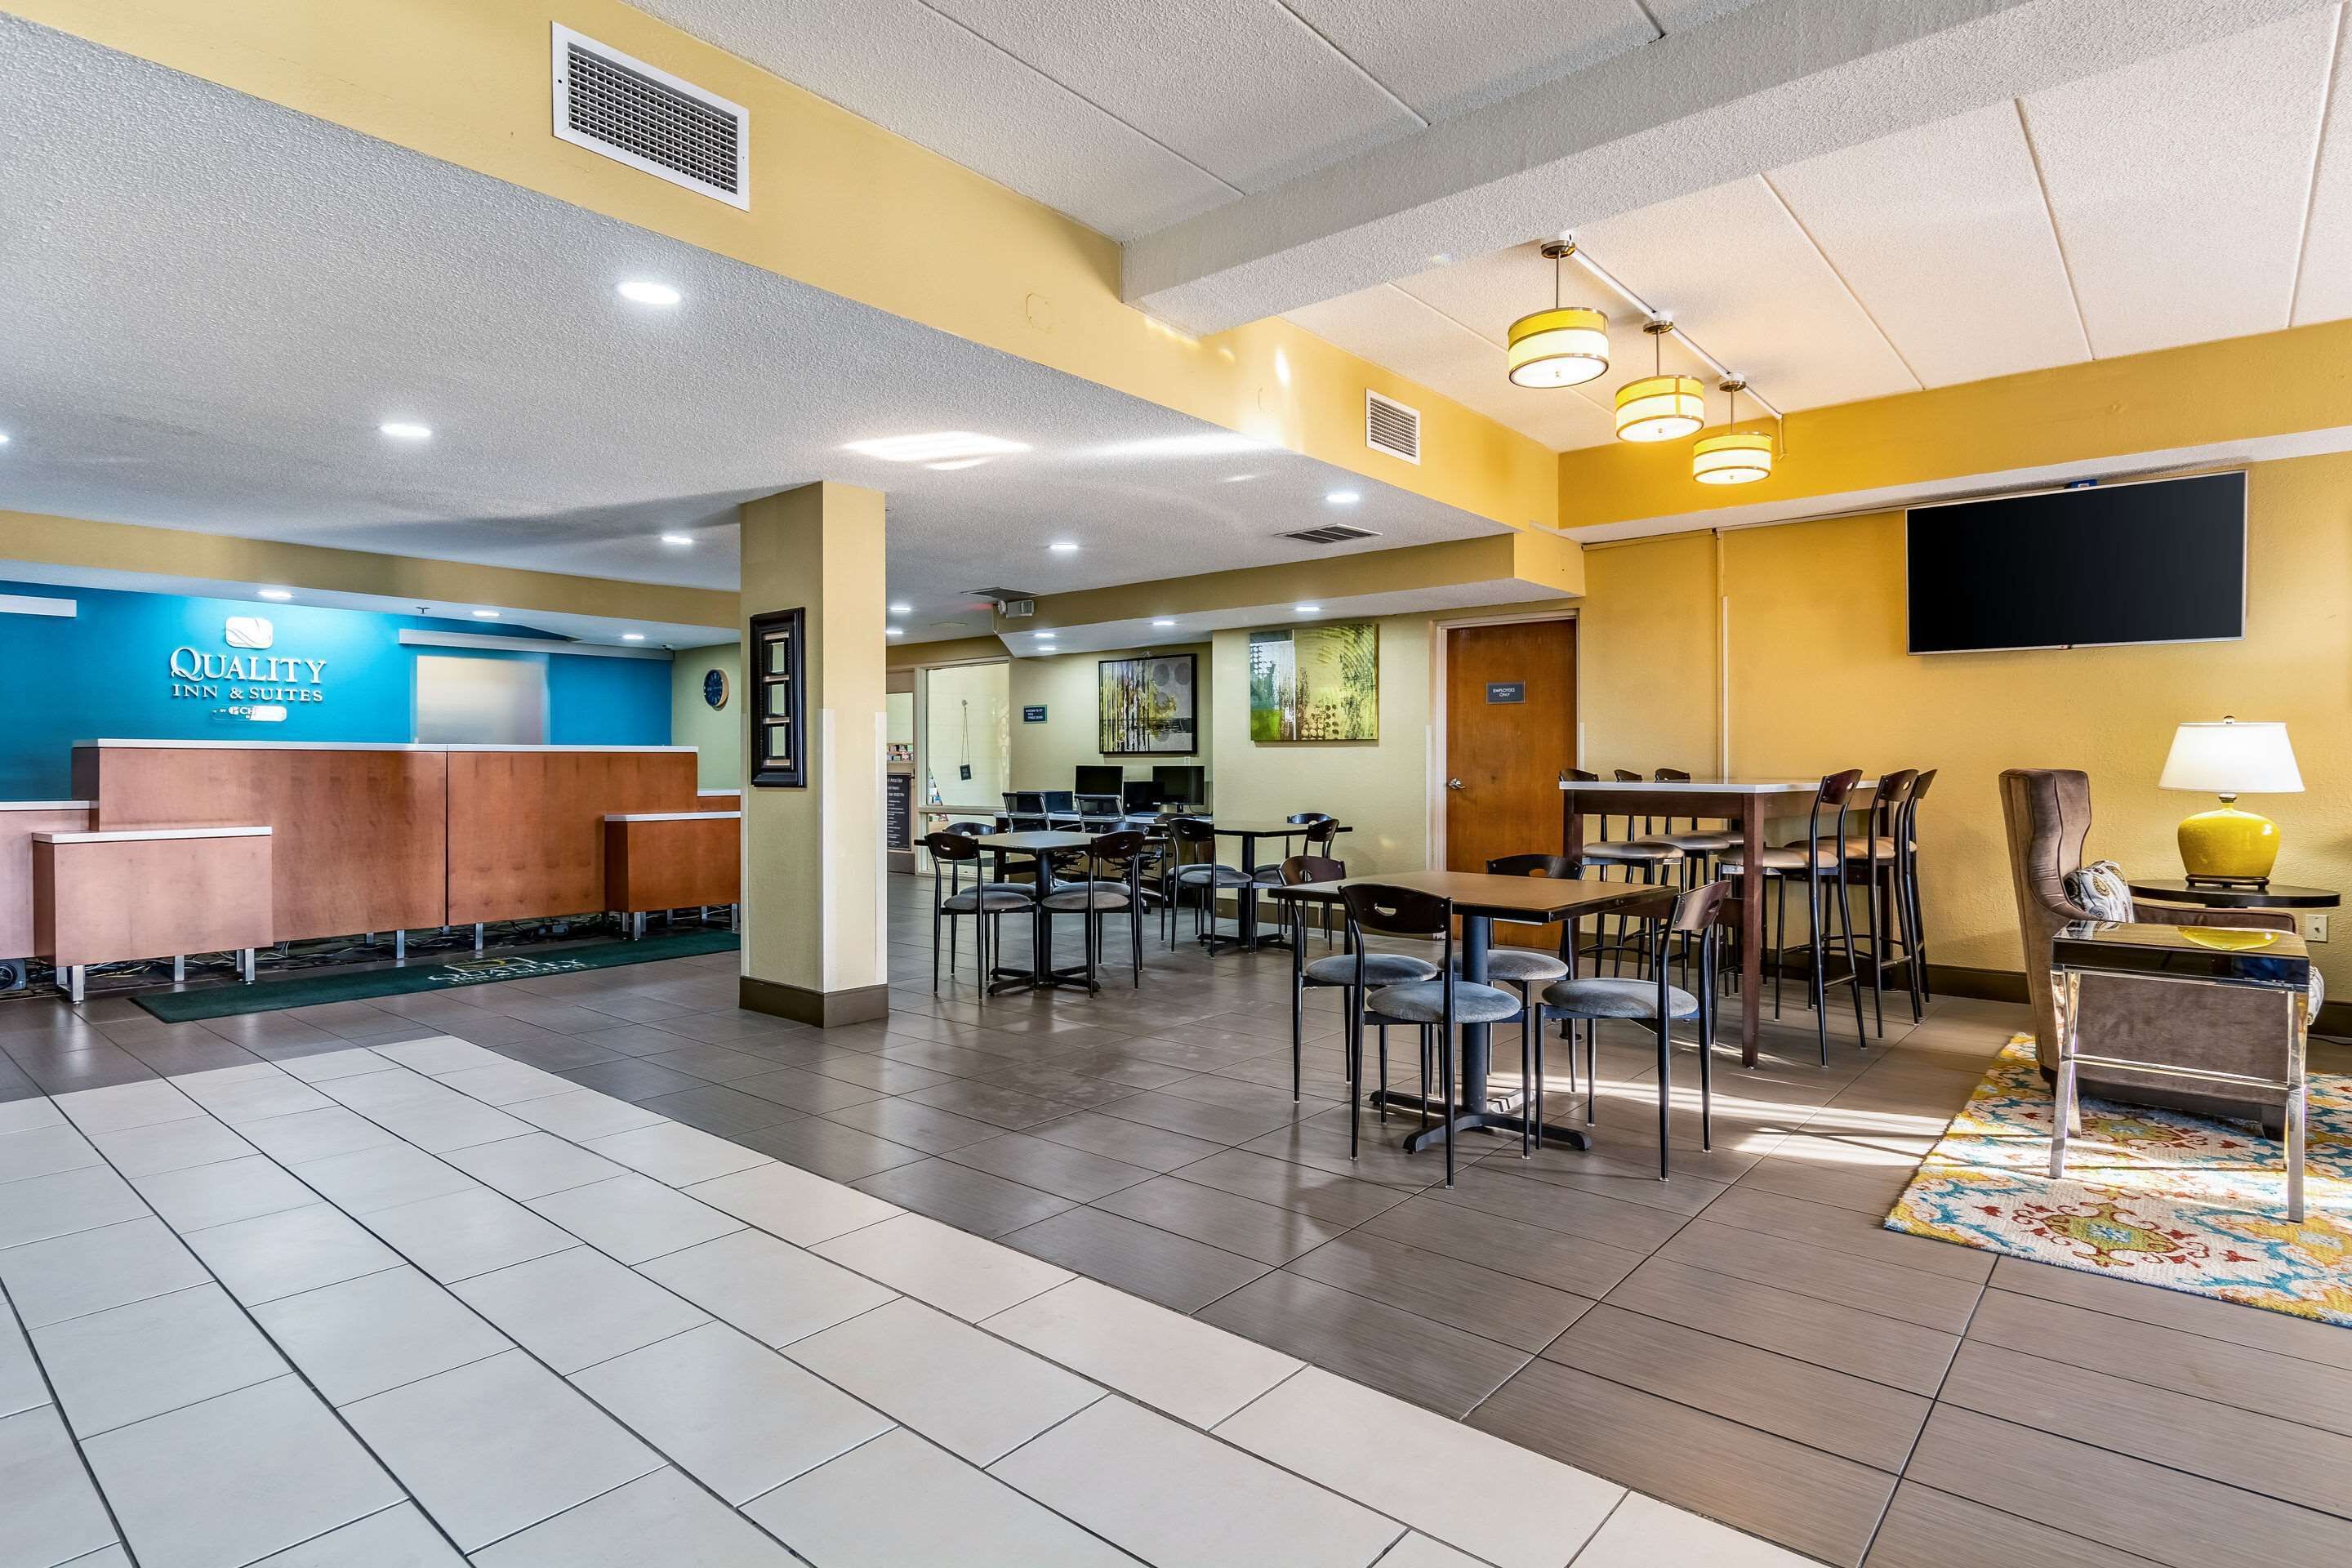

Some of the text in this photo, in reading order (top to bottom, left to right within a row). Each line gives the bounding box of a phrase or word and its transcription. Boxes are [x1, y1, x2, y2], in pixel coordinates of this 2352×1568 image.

[170, 647, 327, 684] QUALITY
[172, 684, 323, 702] INN & SUITES
